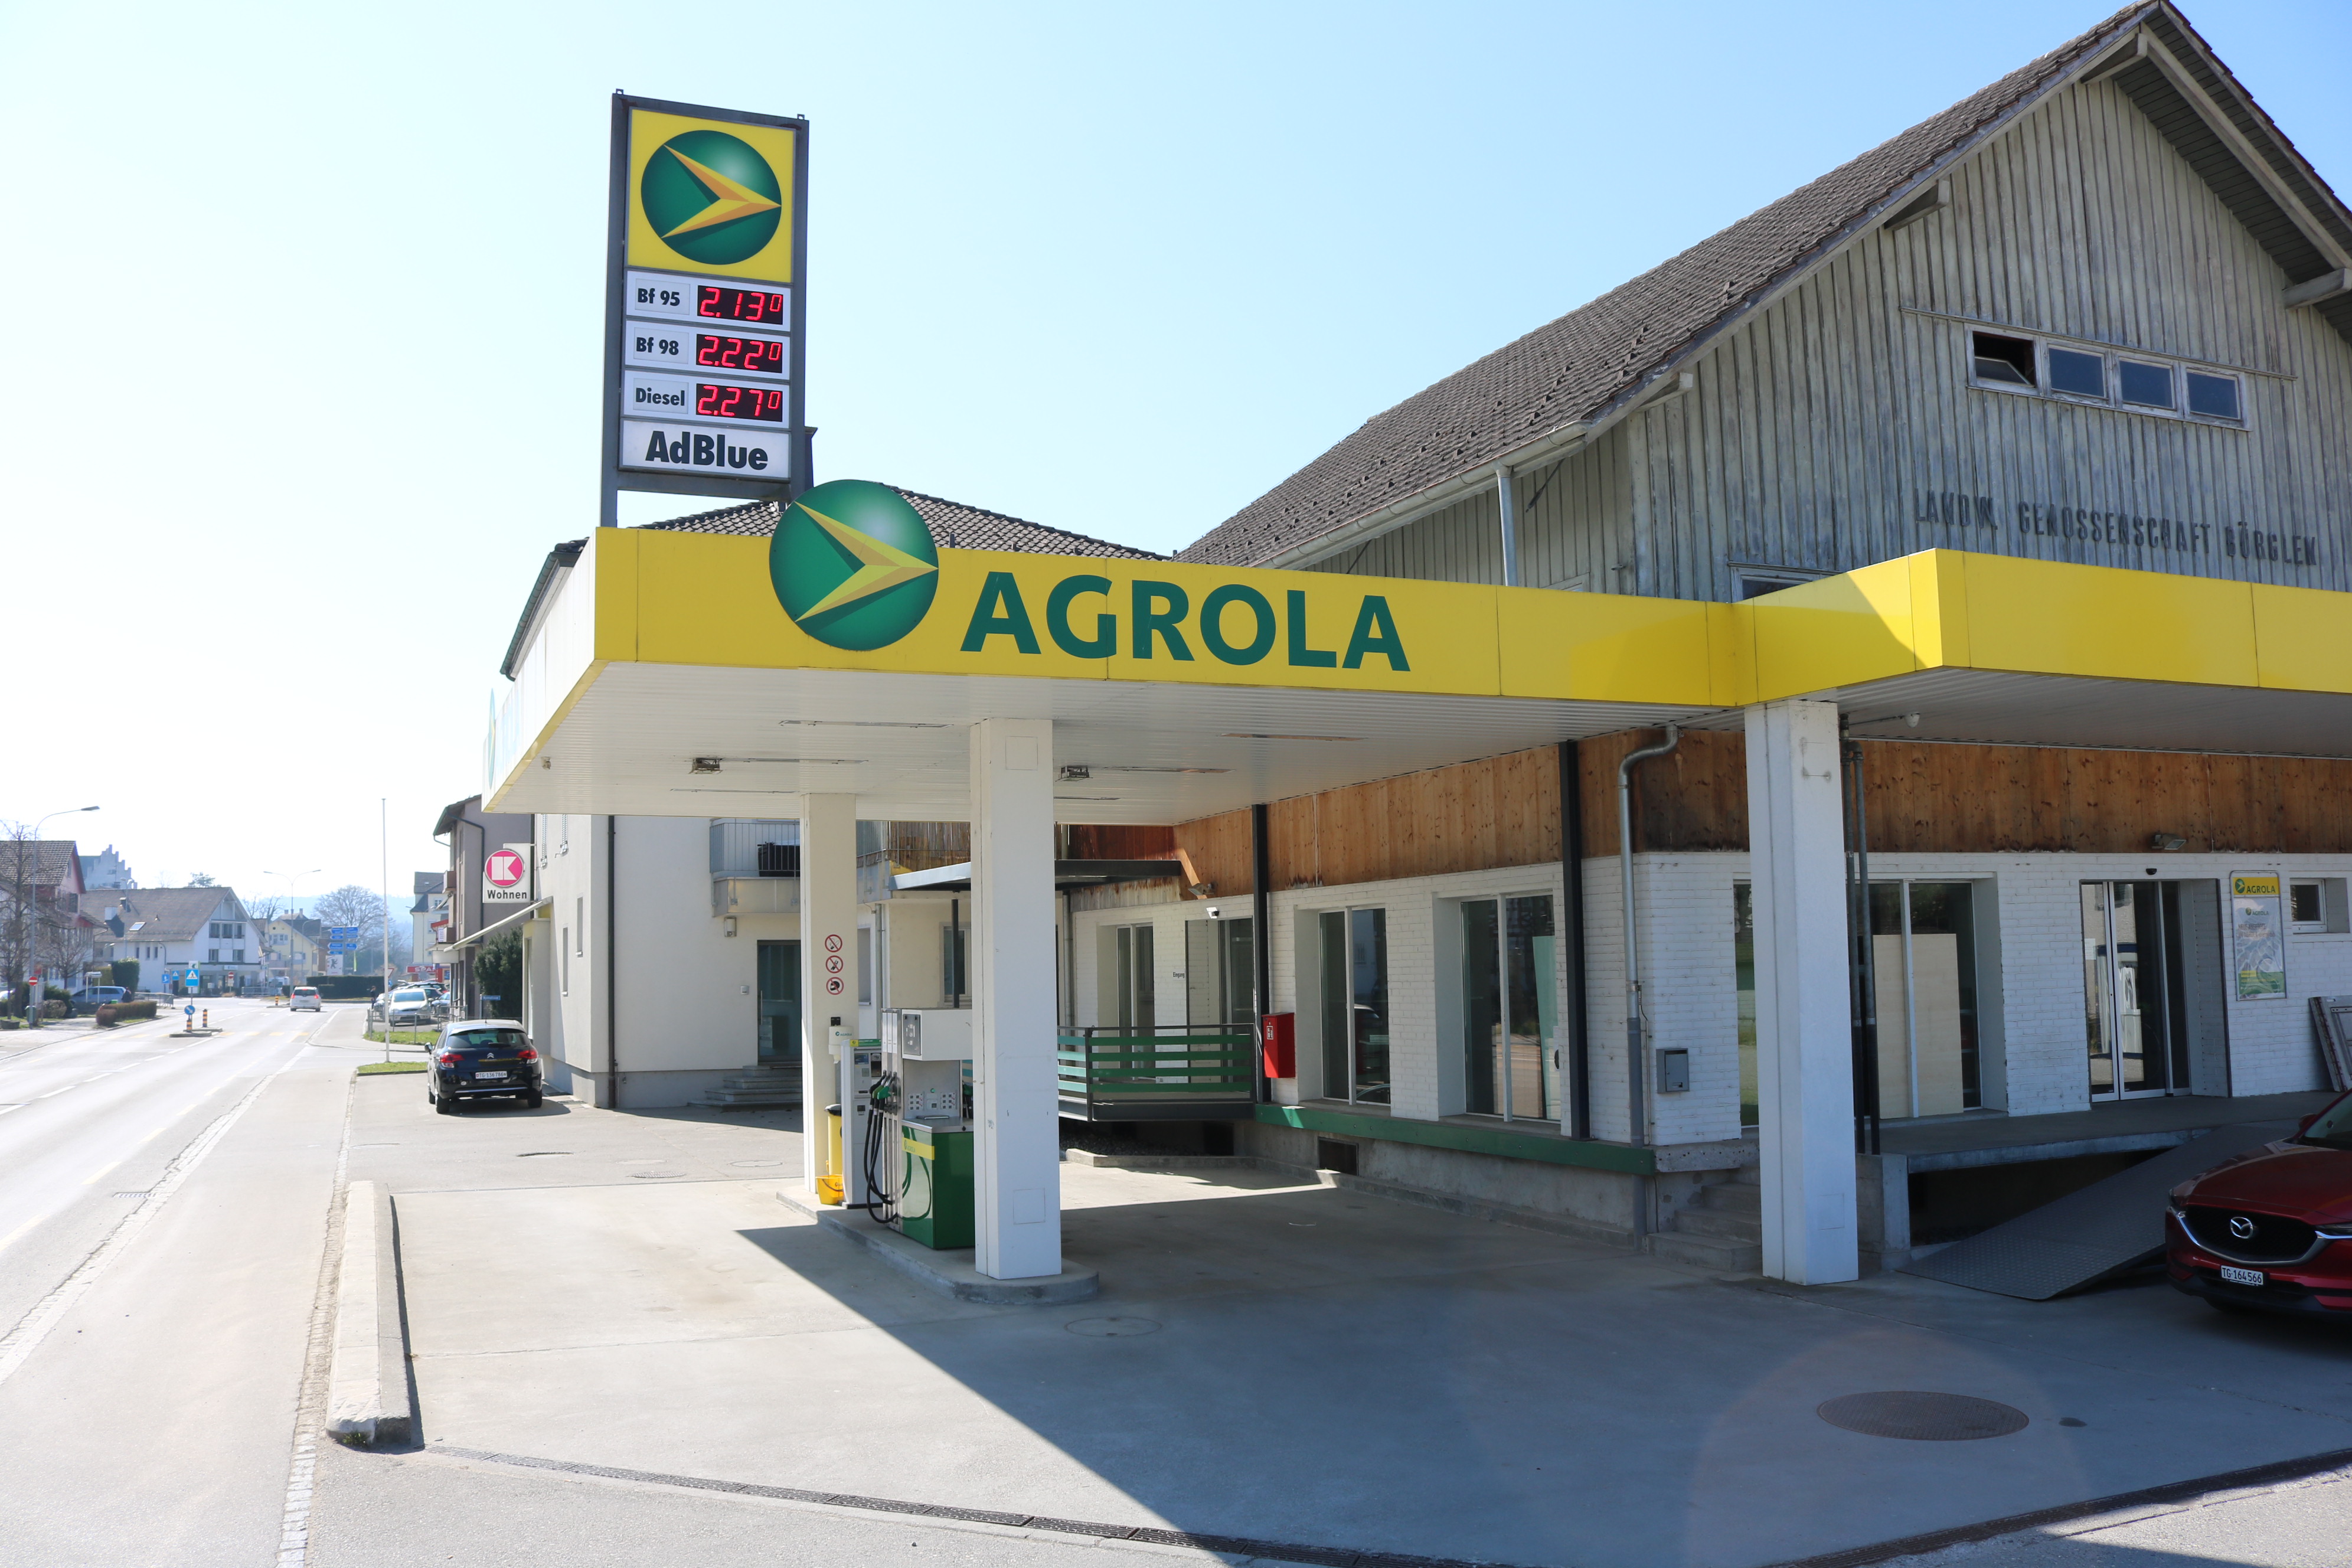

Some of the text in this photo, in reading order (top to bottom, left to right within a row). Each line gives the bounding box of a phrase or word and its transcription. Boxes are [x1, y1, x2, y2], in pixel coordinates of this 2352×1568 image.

[638, 288, 655, 304] Bf
[659, 290, 680, 306] 95
[636, 337, 654, 353] Bf
[659, 339, 679, 355] 98
[636, 387, 685, 406] Diesel
[645, 430, 769, 471] AdBlue
[1915, 488, 2317, 566] LANDW. GENOSSENSCHAFT BÜRGLEN
[960, 571, 1412, 672] AGROLA
[487, 889, 527, 899] Wohnen
[2246, 886, 2276, 894] AGROLA
